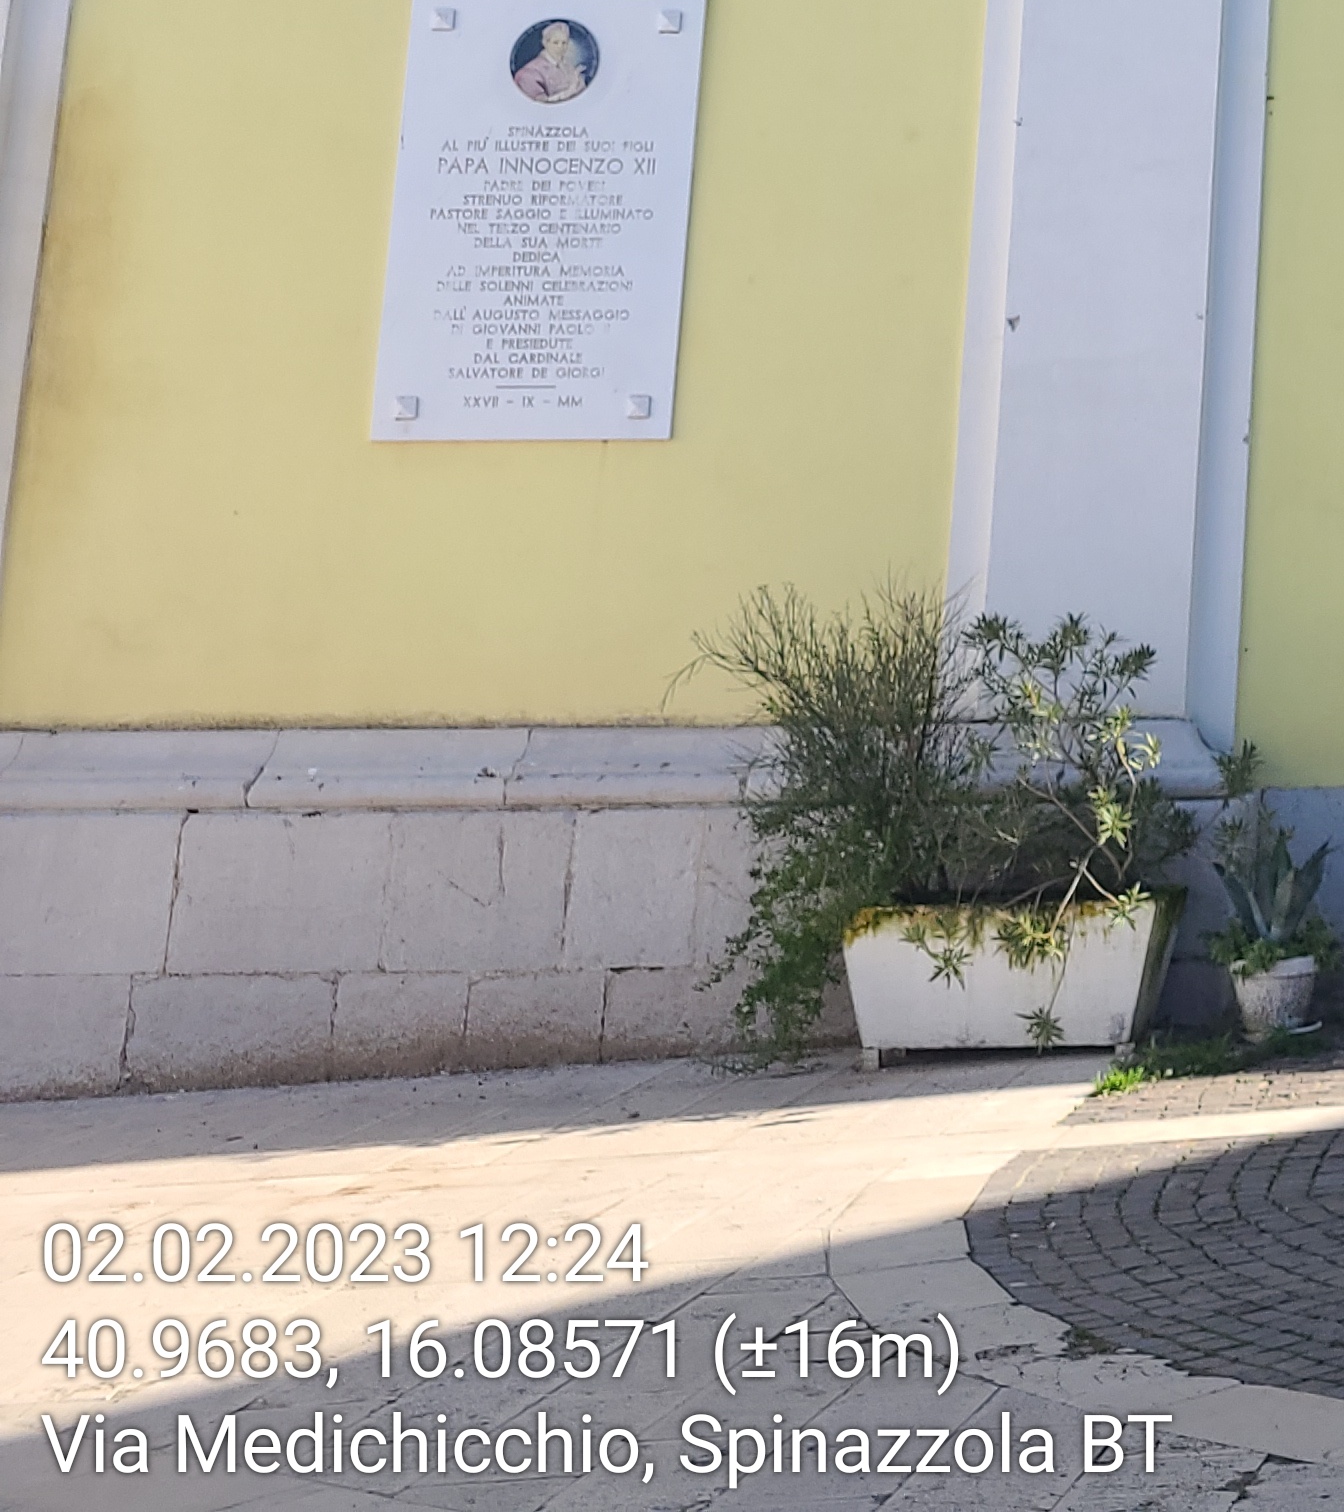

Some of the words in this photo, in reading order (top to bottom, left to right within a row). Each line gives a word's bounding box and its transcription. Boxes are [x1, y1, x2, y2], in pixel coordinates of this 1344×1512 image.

[508, 126, 588, 138] SPINAZZOLA
[441, 140, 458, 152] AL
[495, 140, 549, 152] ILLUSTRE
[557, 140, 576, 152] DEI
[623, 140, 654, 152] FIGLI
[438, 157, 489, 175] PAPA
[499, 157, 624, 175] INNOCENZO
[634, 157, 656, 175] XII
[532, 180, 550, 192] DEI
[463, 194, 522, 206] STRENUO
[430, 208, 488, 220] PASTORE
[495, 208, 551, 220] SAGGIO
[457, 223, 479, 234] NEL
[489, 223, 530, 234] TERZO
[538, 223, 621, 234] CENTENARIO
[474, 238, 512, 249] DELLA
[521, 238, 548, 249] SUA
[512, 251, 561, 263] DEDICA
[446, 266, 466, 277] AD
[475, 266, 550, 277] IMPERITURA
[560, 266, 625, 277] MEMORIA
[479, 280, 534, 292] SOLENNI
[542, 280, 633, 292] CELEBRAZIONI
[503, 295, 564, 307] ANIMATE
[472, 309, 540, 321] AUGUSTO
[549, 309, 630, 321] MESSAGGIO
[472, 324, 541, 335] GIOVANNI
[549, 324, 594, 335] PAOLO
[501, 338, 573, 350] PRESIEDUTE
[474, 353, 500, 365] DAL
[508, 353, 583, 365] CARDINALE
[449, 367, 523, 380] SALVATORE
[532, 367, 547, 380] DE
[463, 396, 499, 408] XXVII
[522, 396, 534, 408] IX
[557, 396, 583, 408] MM
